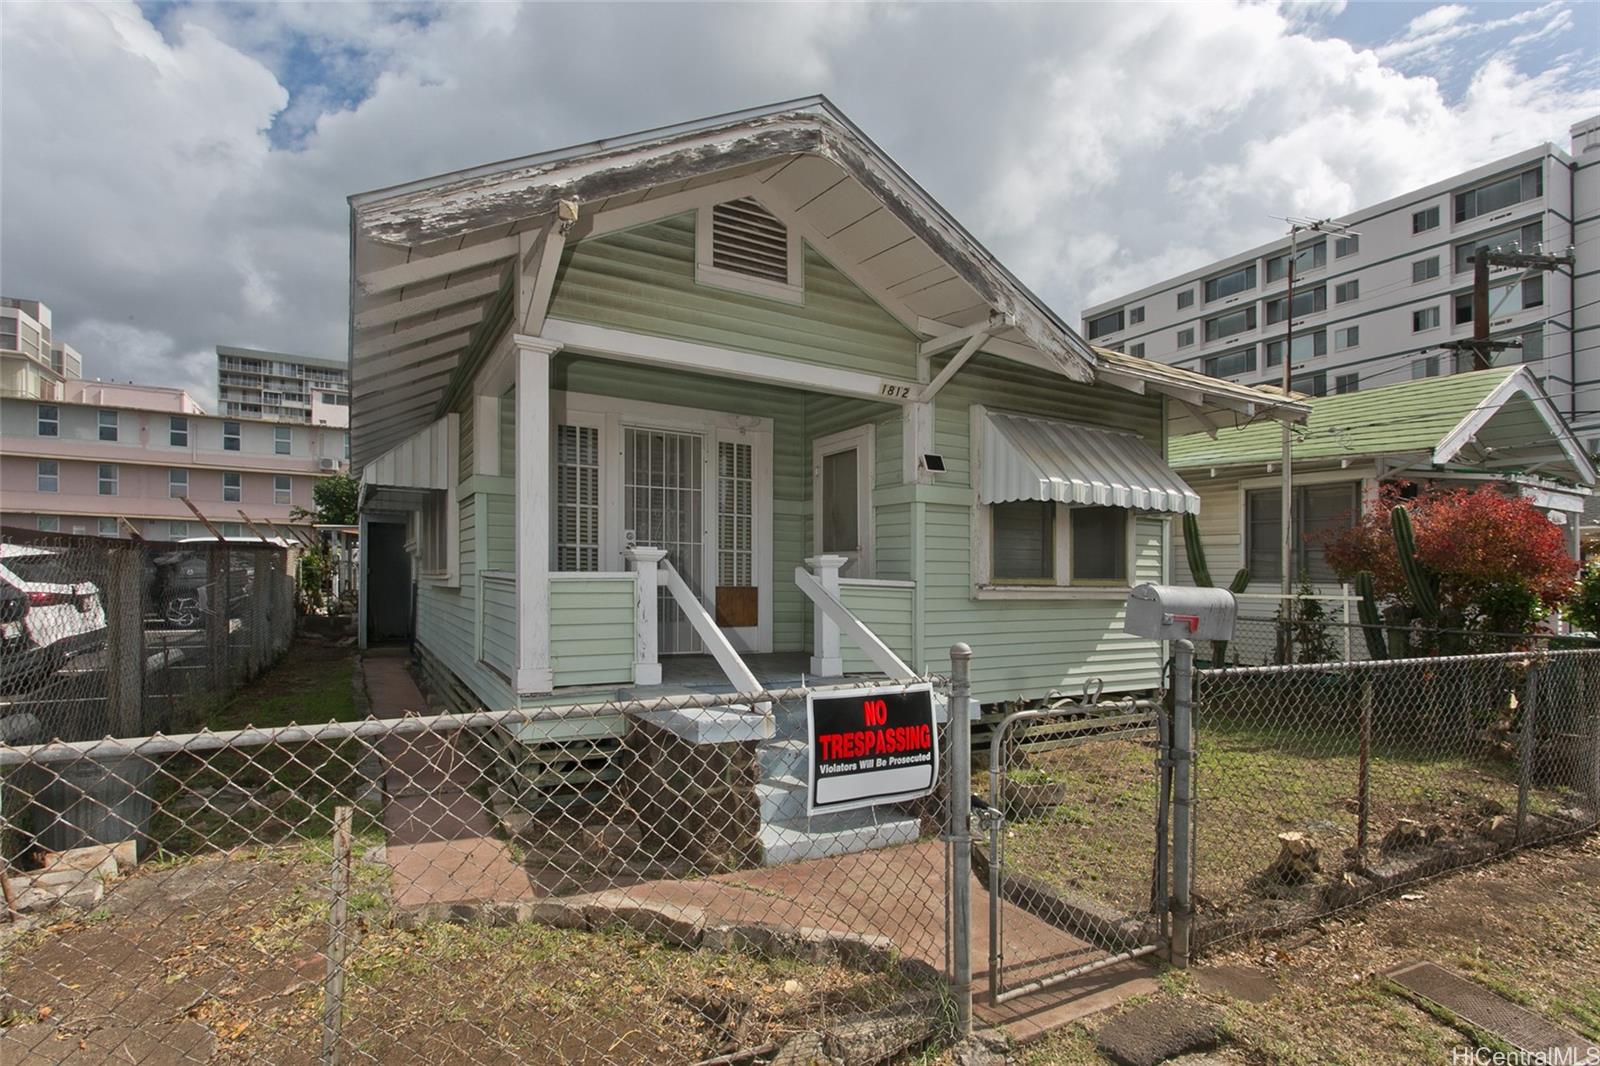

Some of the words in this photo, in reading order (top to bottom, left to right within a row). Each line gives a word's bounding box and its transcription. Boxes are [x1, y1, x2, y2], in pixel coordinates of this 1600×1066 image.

[882, 384, 910, 398] 1812
[863, 700, 888, 726] NO
[819, 724, 931, 760] TRESPASSING
[819, 763, 857, 774] Violators
[859, 759, 874, 770] Will
[876, 758, 887, 767] Be
[889, 752, 931, 765] Prosecuted
